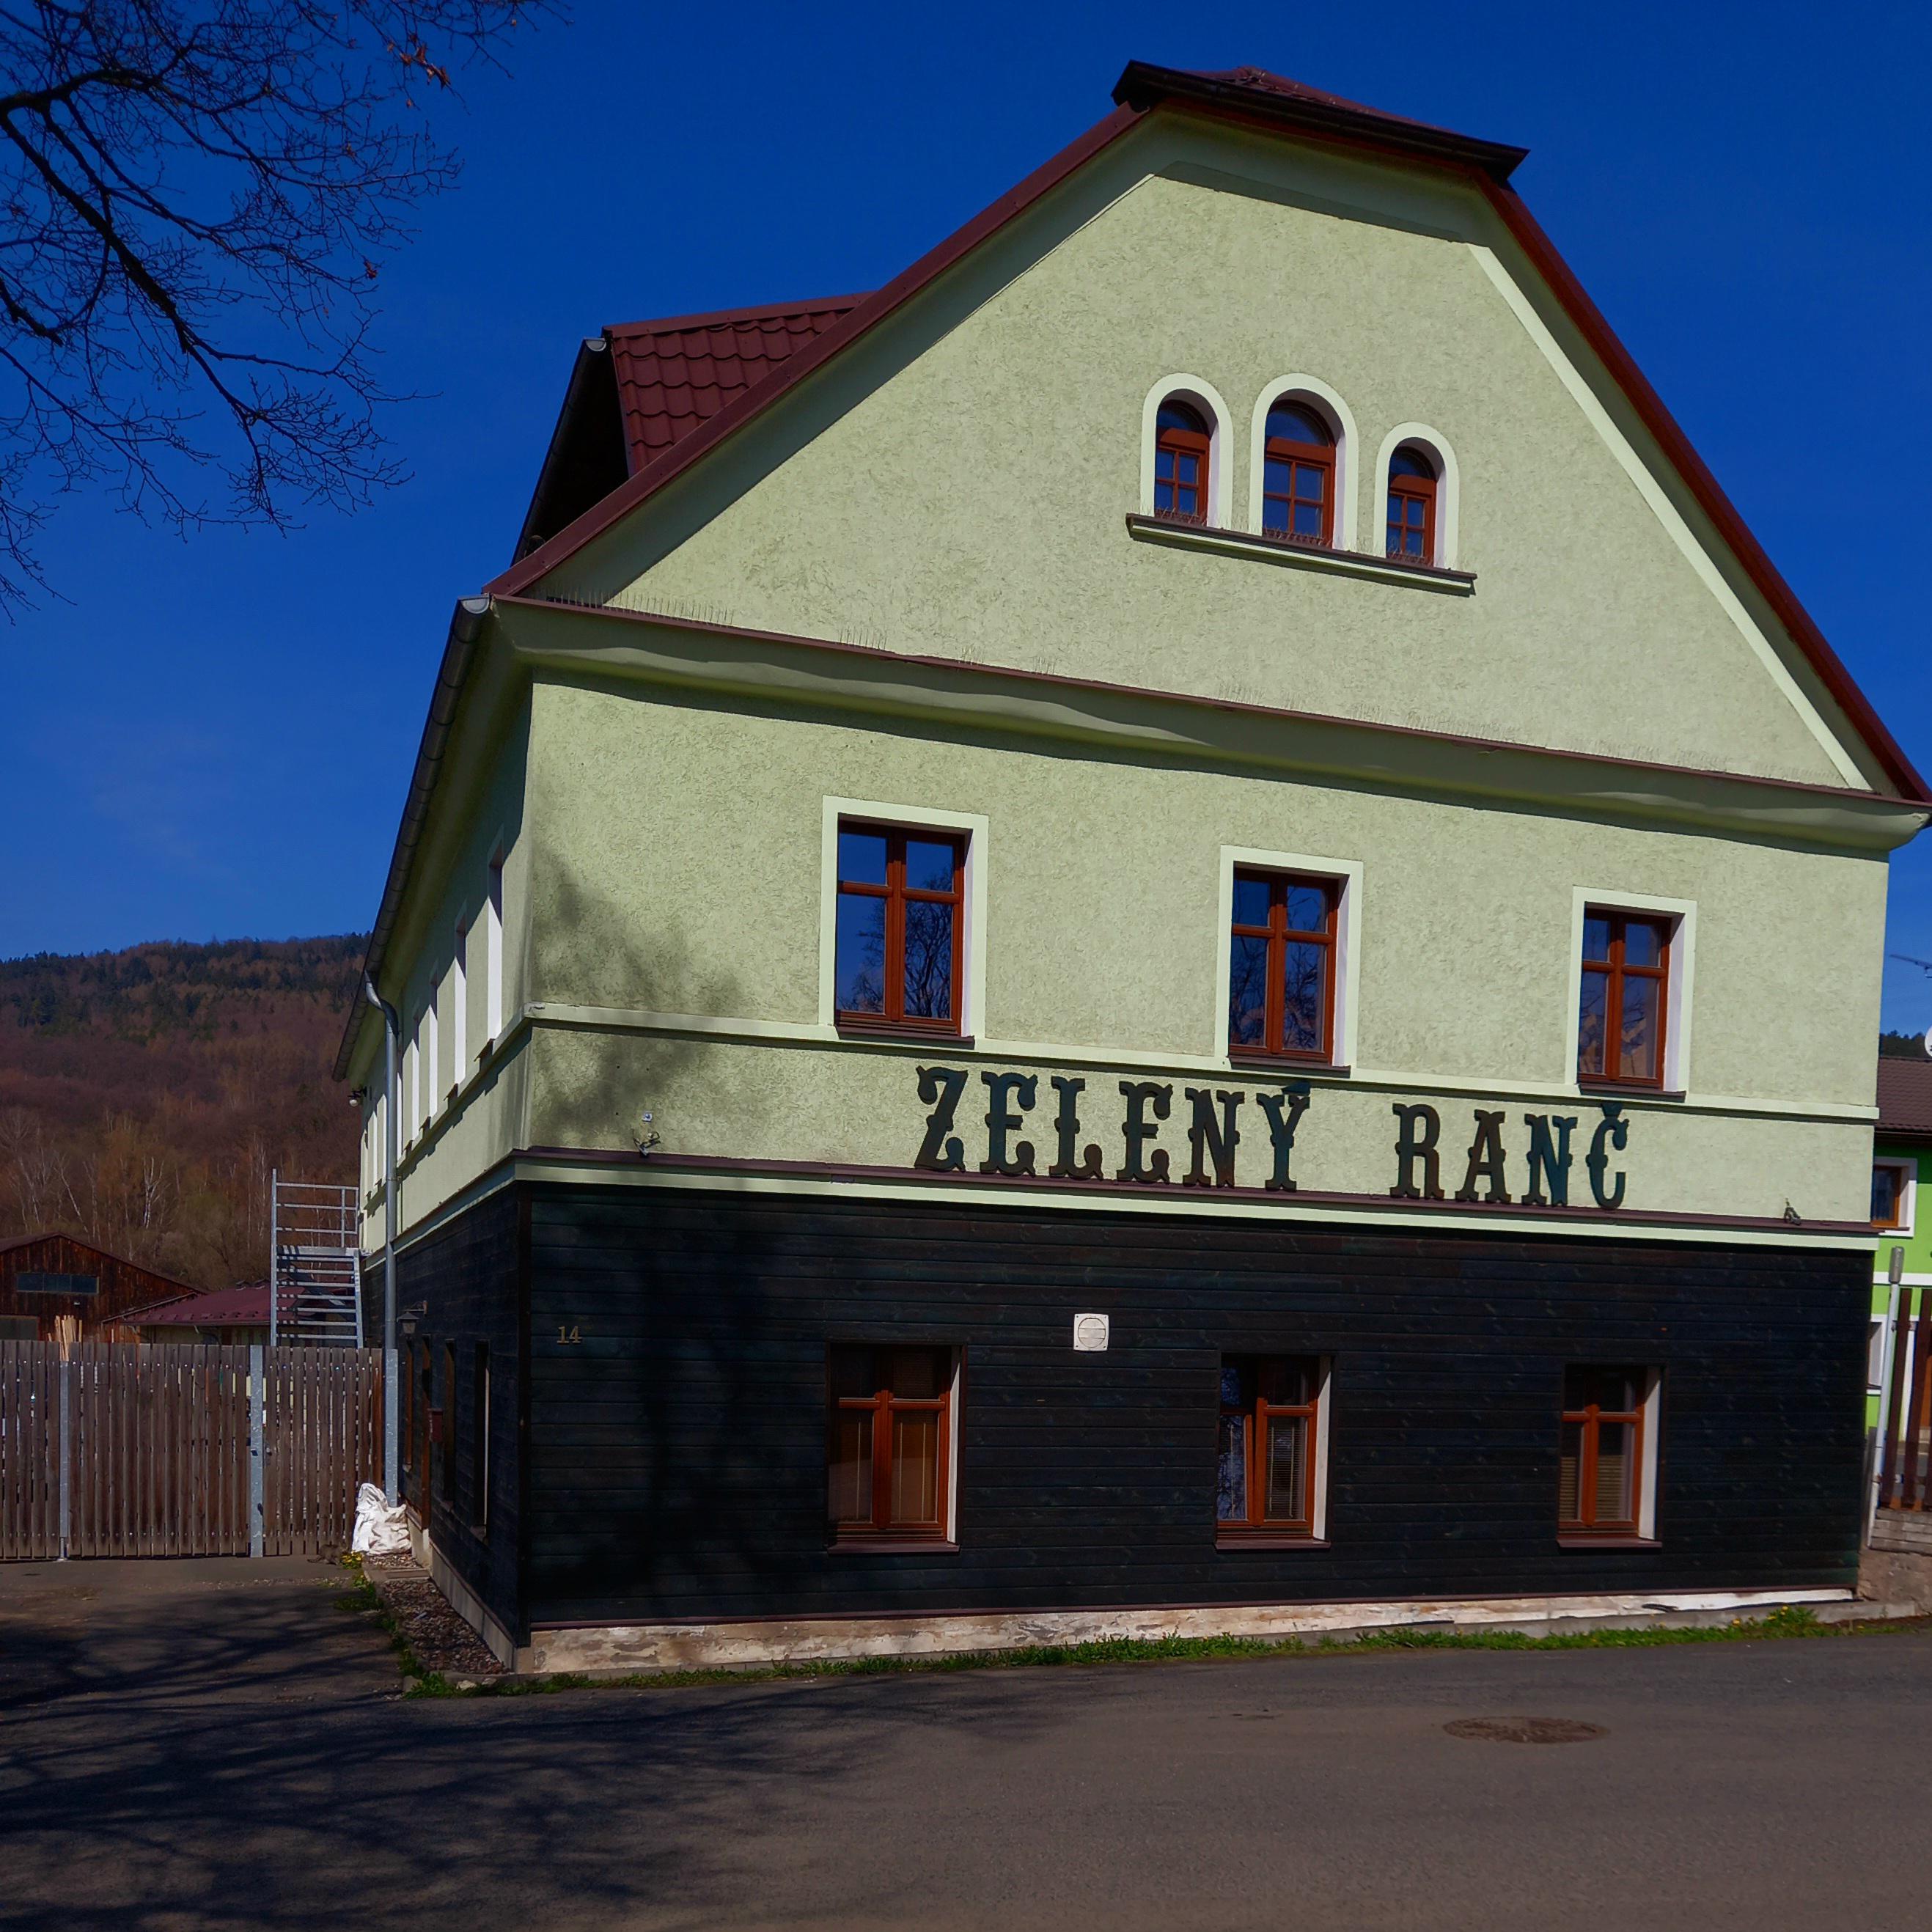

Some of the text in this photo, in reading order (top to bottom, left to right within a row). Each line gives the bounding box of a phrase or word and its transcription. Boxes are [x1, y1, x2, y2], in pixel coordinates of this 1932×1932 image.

[914, 1065, 1630, 1210] ZELENÝ RANČ
[557, 1326, 583, 1345] 14
